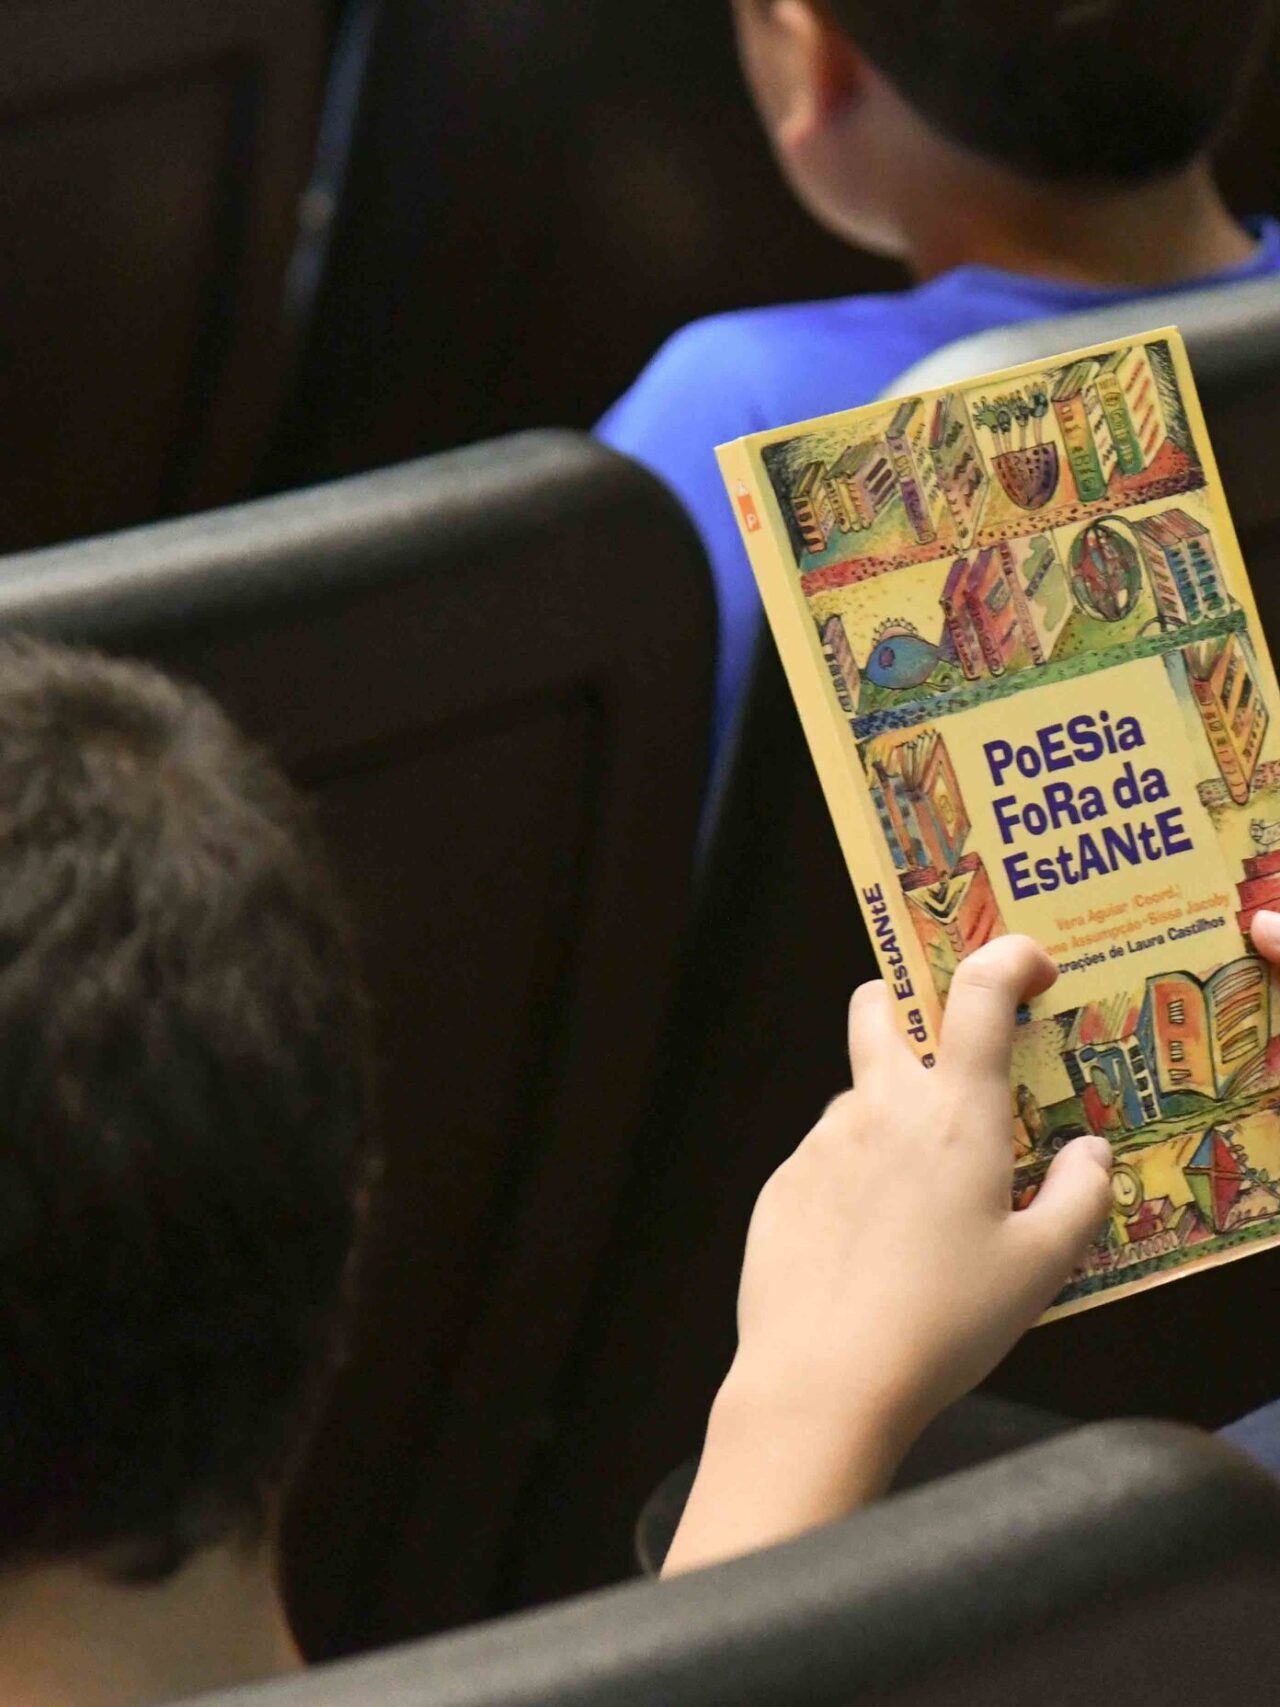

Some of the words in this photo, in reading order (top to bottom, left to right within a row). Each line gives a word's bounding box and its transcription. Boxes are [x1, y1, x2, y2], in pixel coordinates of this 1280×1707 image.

[982, 710, 1146, 787] PoESia
[992, 781, 1108, 845] FoRa
[1112, 761, 1170, 809] da
[1002, 806, 1194, 901] EstANtE
[862, 882, 915, 1001] EstANtE
[1088, 903, 1128, 924] Aguiar
[1109, 945, 1125, 959] de
[1127, 934, 1165, 953] Laura
[1167, 916, 1226, 941] Castilhos
[907, 1008, 927, 1043] da
